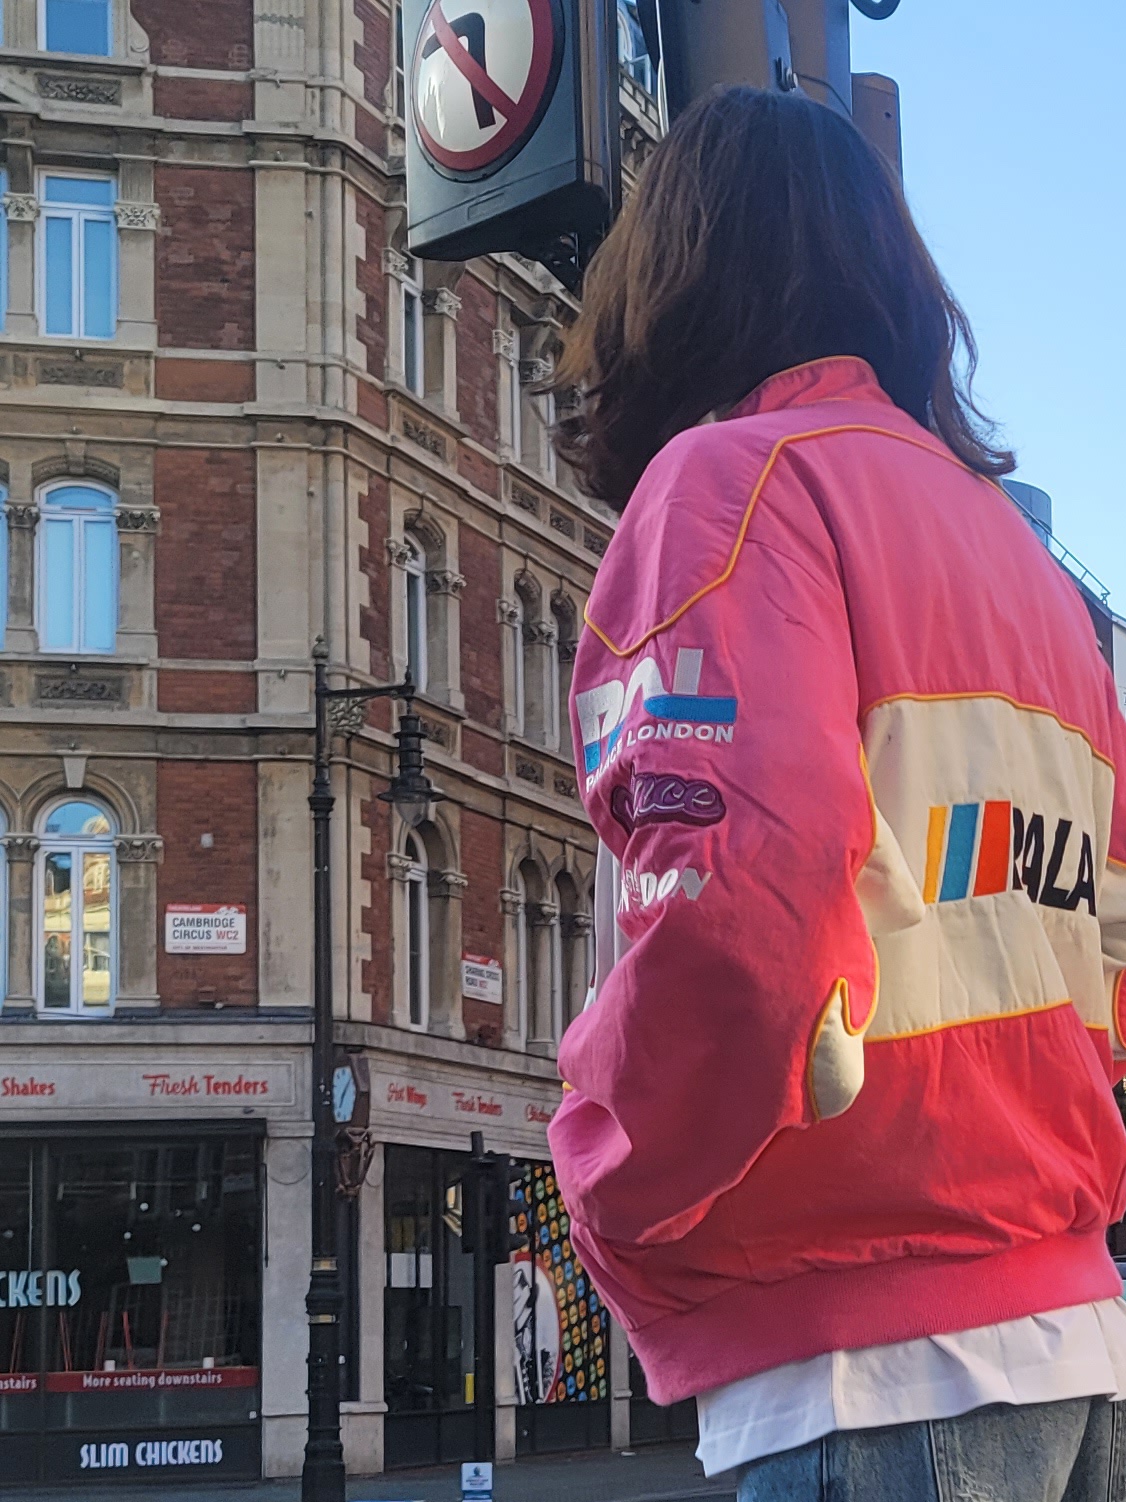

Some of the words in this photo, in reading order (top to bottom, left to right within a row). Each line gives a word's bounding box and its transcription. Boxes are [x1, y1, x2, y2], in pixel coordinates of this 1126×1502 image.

[626, 722, 735, 744] LONDON
[172, 917, 236, 928] CAMBRIDGE
[172, 930, 212, 941] CIRCUS
[215, 930, 240, 941] WC2
[1, 1077, 56, 1097] Shakes
[142, 1074, 200, 1097] Fresh
[203, 1075, 269, 1096] Tenders
[83, 1374, 110, 1388] More
[113, 1372, 156, 1388] seating
[158, 1371, 223, 1386] downstairs
[80, 1443, 130, 1469] SLIM
[135, 1438, 224, 1467] CHICKENS
